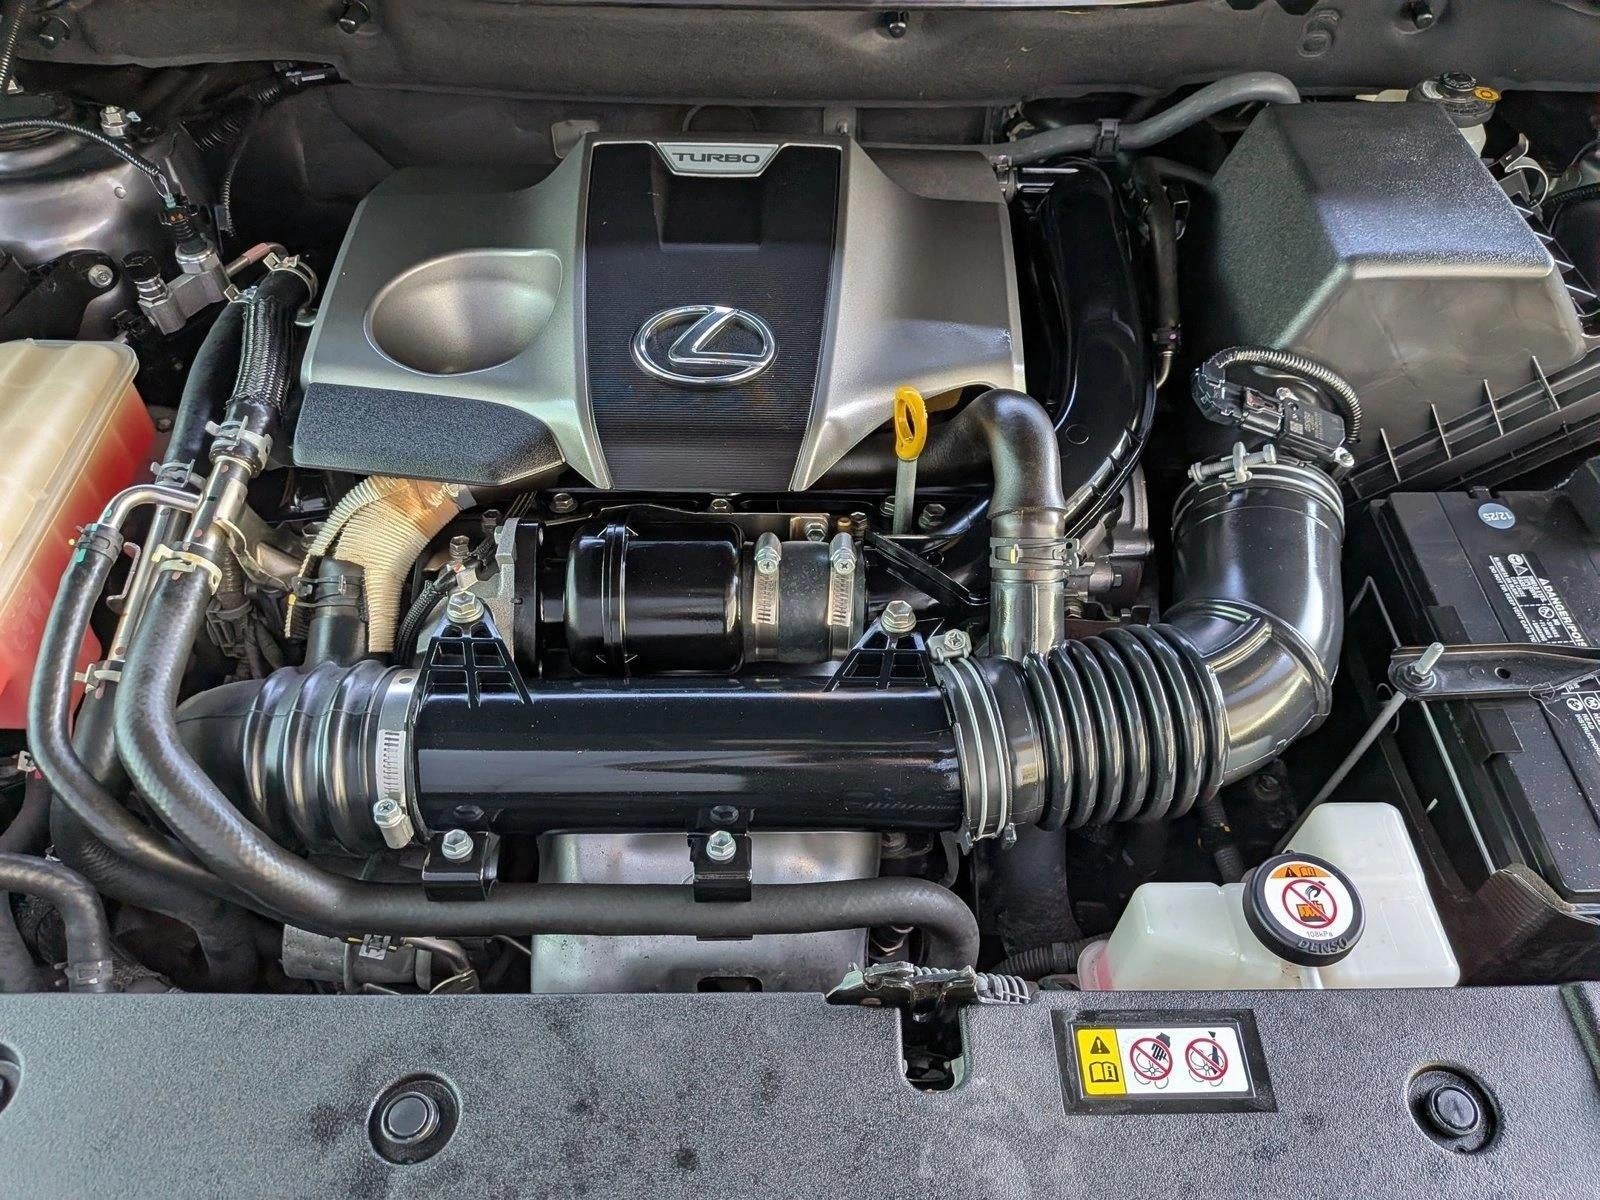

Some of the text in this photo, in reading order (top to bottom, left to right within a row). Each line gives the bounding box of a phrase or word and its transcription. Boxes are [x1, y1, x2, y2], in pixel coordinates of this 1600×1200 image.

[672, 152, 760, 164] TURBO
[1482, 511, 1513, 522] 12/25
[1306, 930, 1334, 938] 108kPa
[1297, 937, 1348, 954] DENSO
